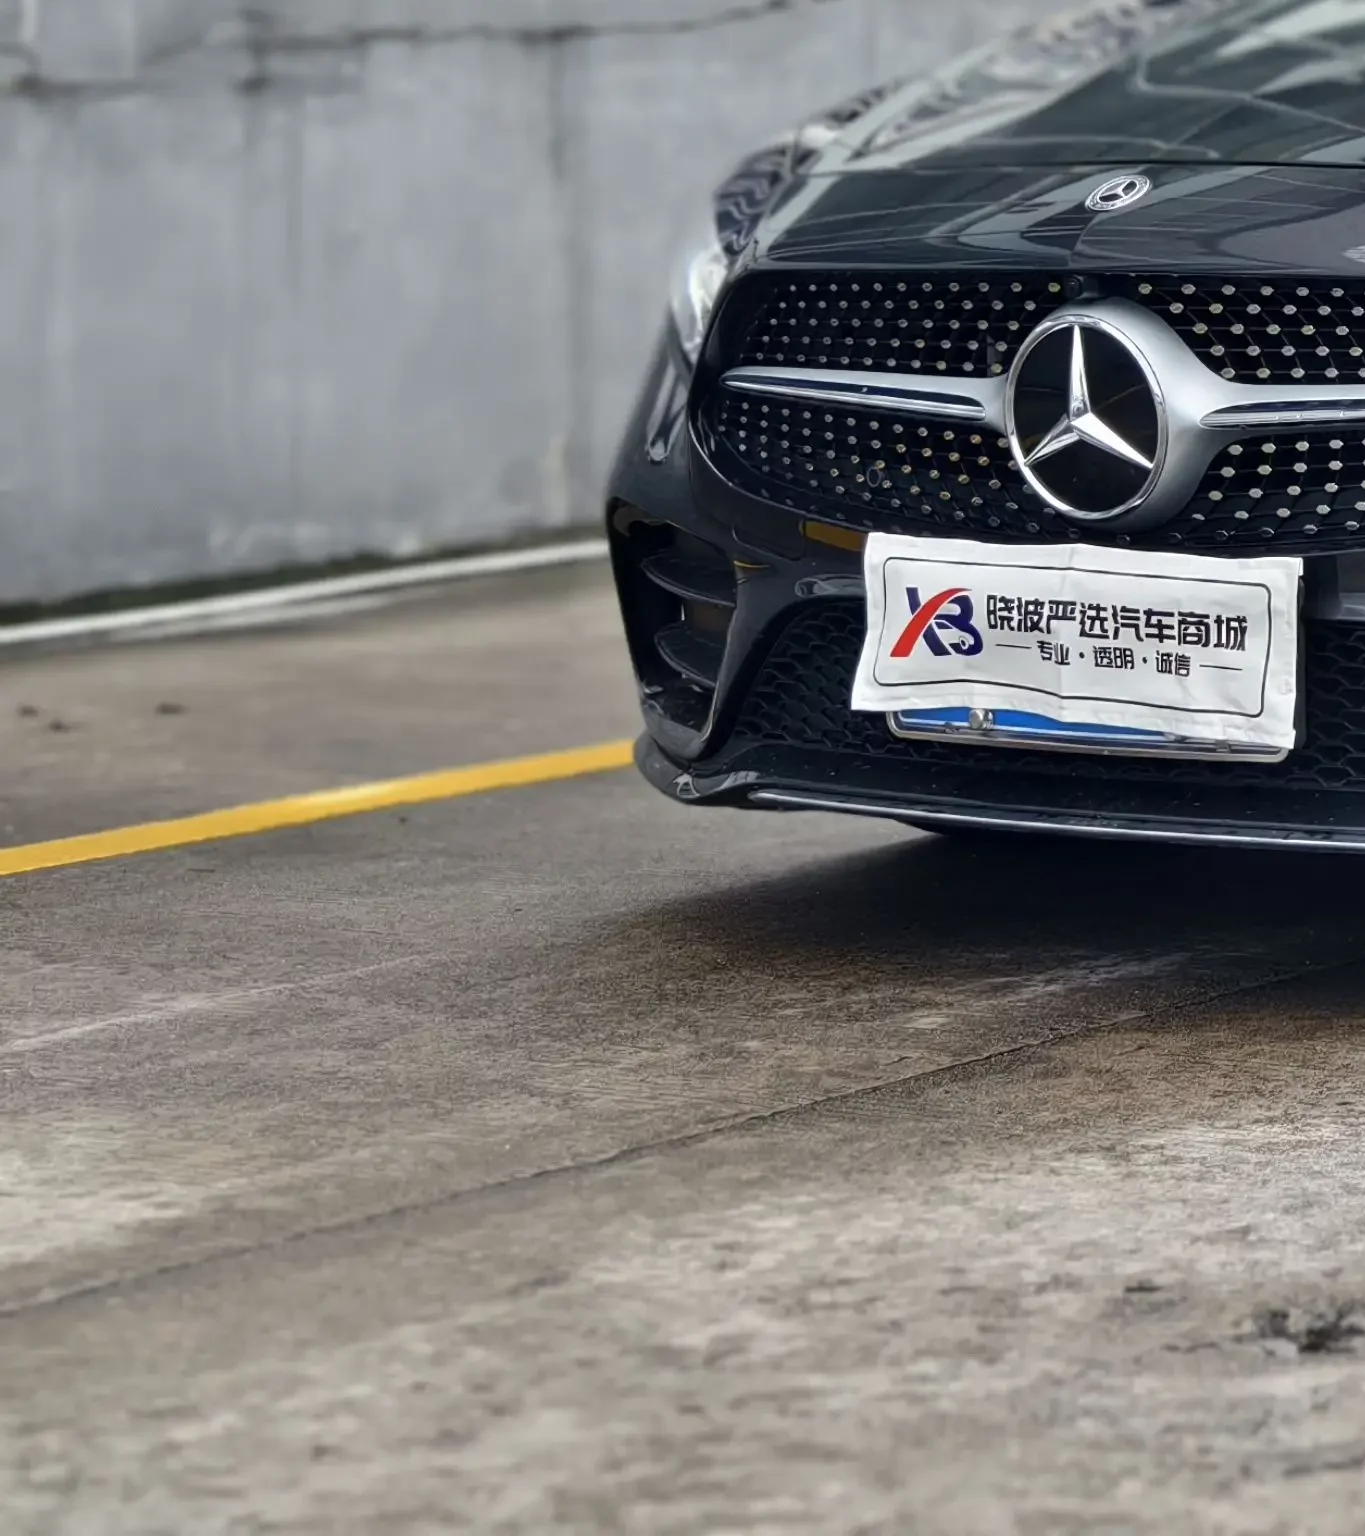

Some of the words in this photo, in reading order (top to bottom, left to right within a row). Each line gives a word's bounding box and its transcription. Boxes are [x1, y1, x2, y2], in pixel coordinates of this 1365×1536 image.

[985, 593, 1249, 652] 晓波严选汽车商城
